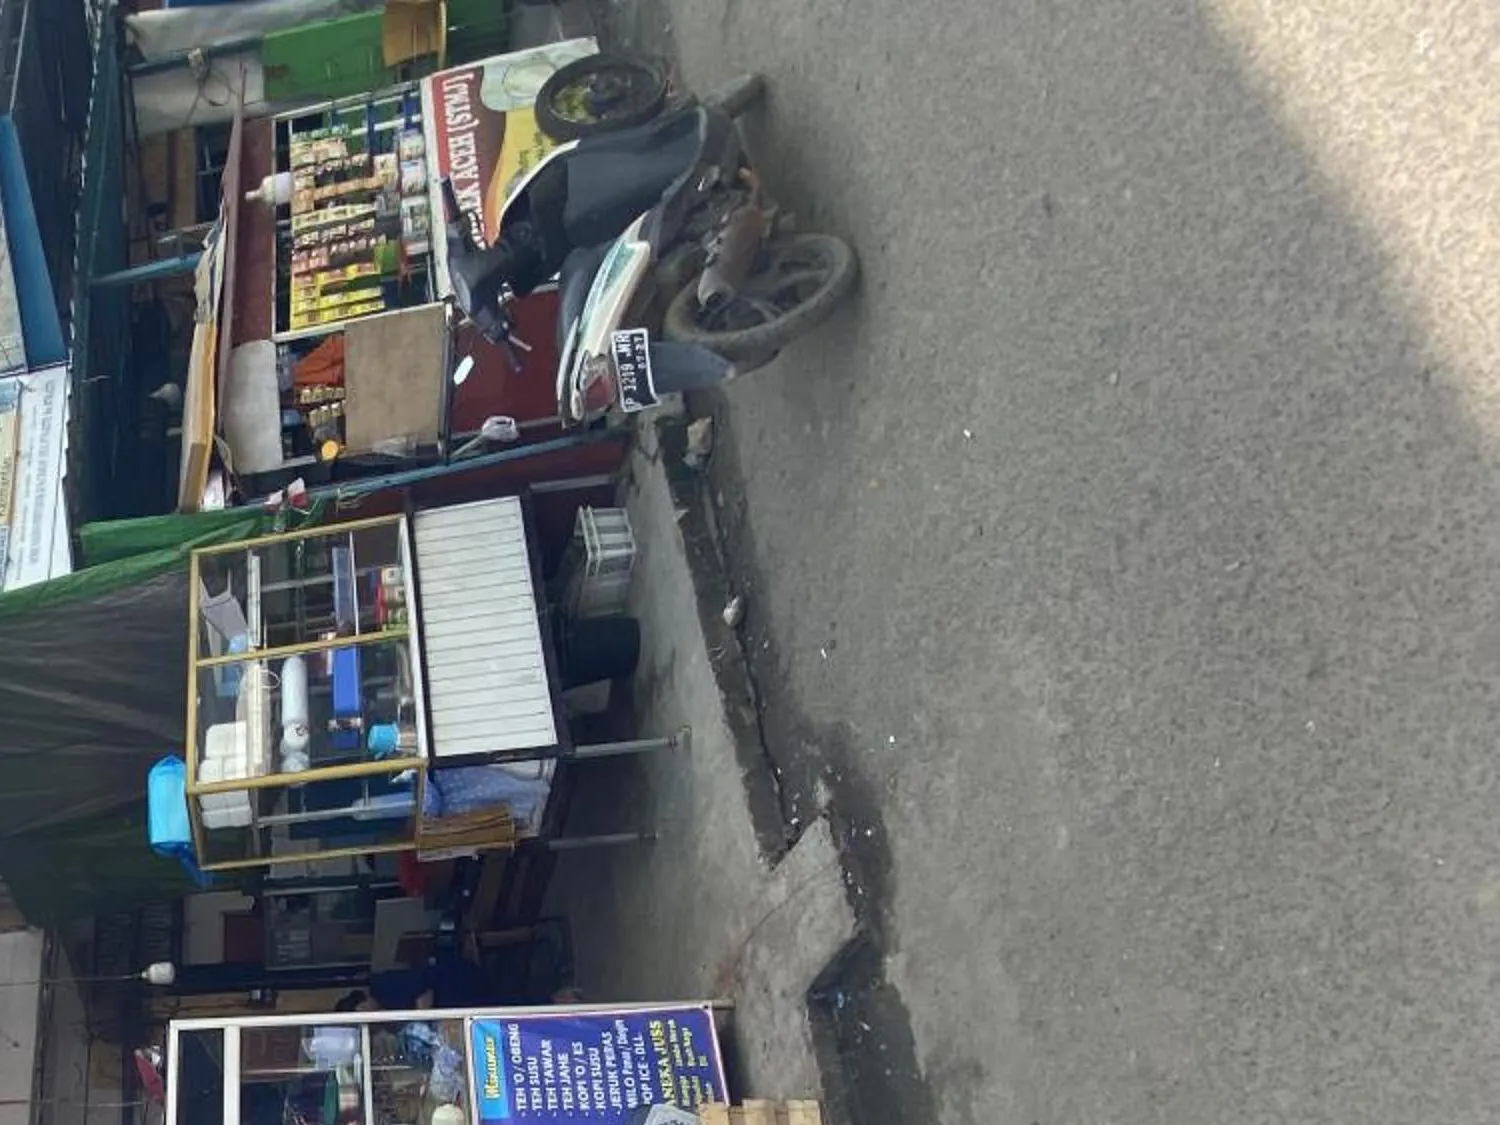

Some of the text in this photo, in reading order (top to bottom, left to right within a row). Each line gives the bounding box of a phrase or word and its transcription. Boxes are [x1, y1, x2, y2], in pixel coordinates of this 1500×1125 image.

[446, 131, 479, 179] ACEH
[527, 1056, 543, 1110] TEH SUSU
[541, 1038, 560, 1110] TEH TAWAR
[557, 1052, 575, 1110] TEH JAHE
[588, 1047, 608, 1110] KOPI SUSU
[606, 1070, 623, 1111] JERUK
[623, 1077, 639, 1108] MILO
[637, 1062, 651, 1081] ICE
[515, 1087, 528, 1110] TEH
[577, 1080, 591, 1110] KOPI
